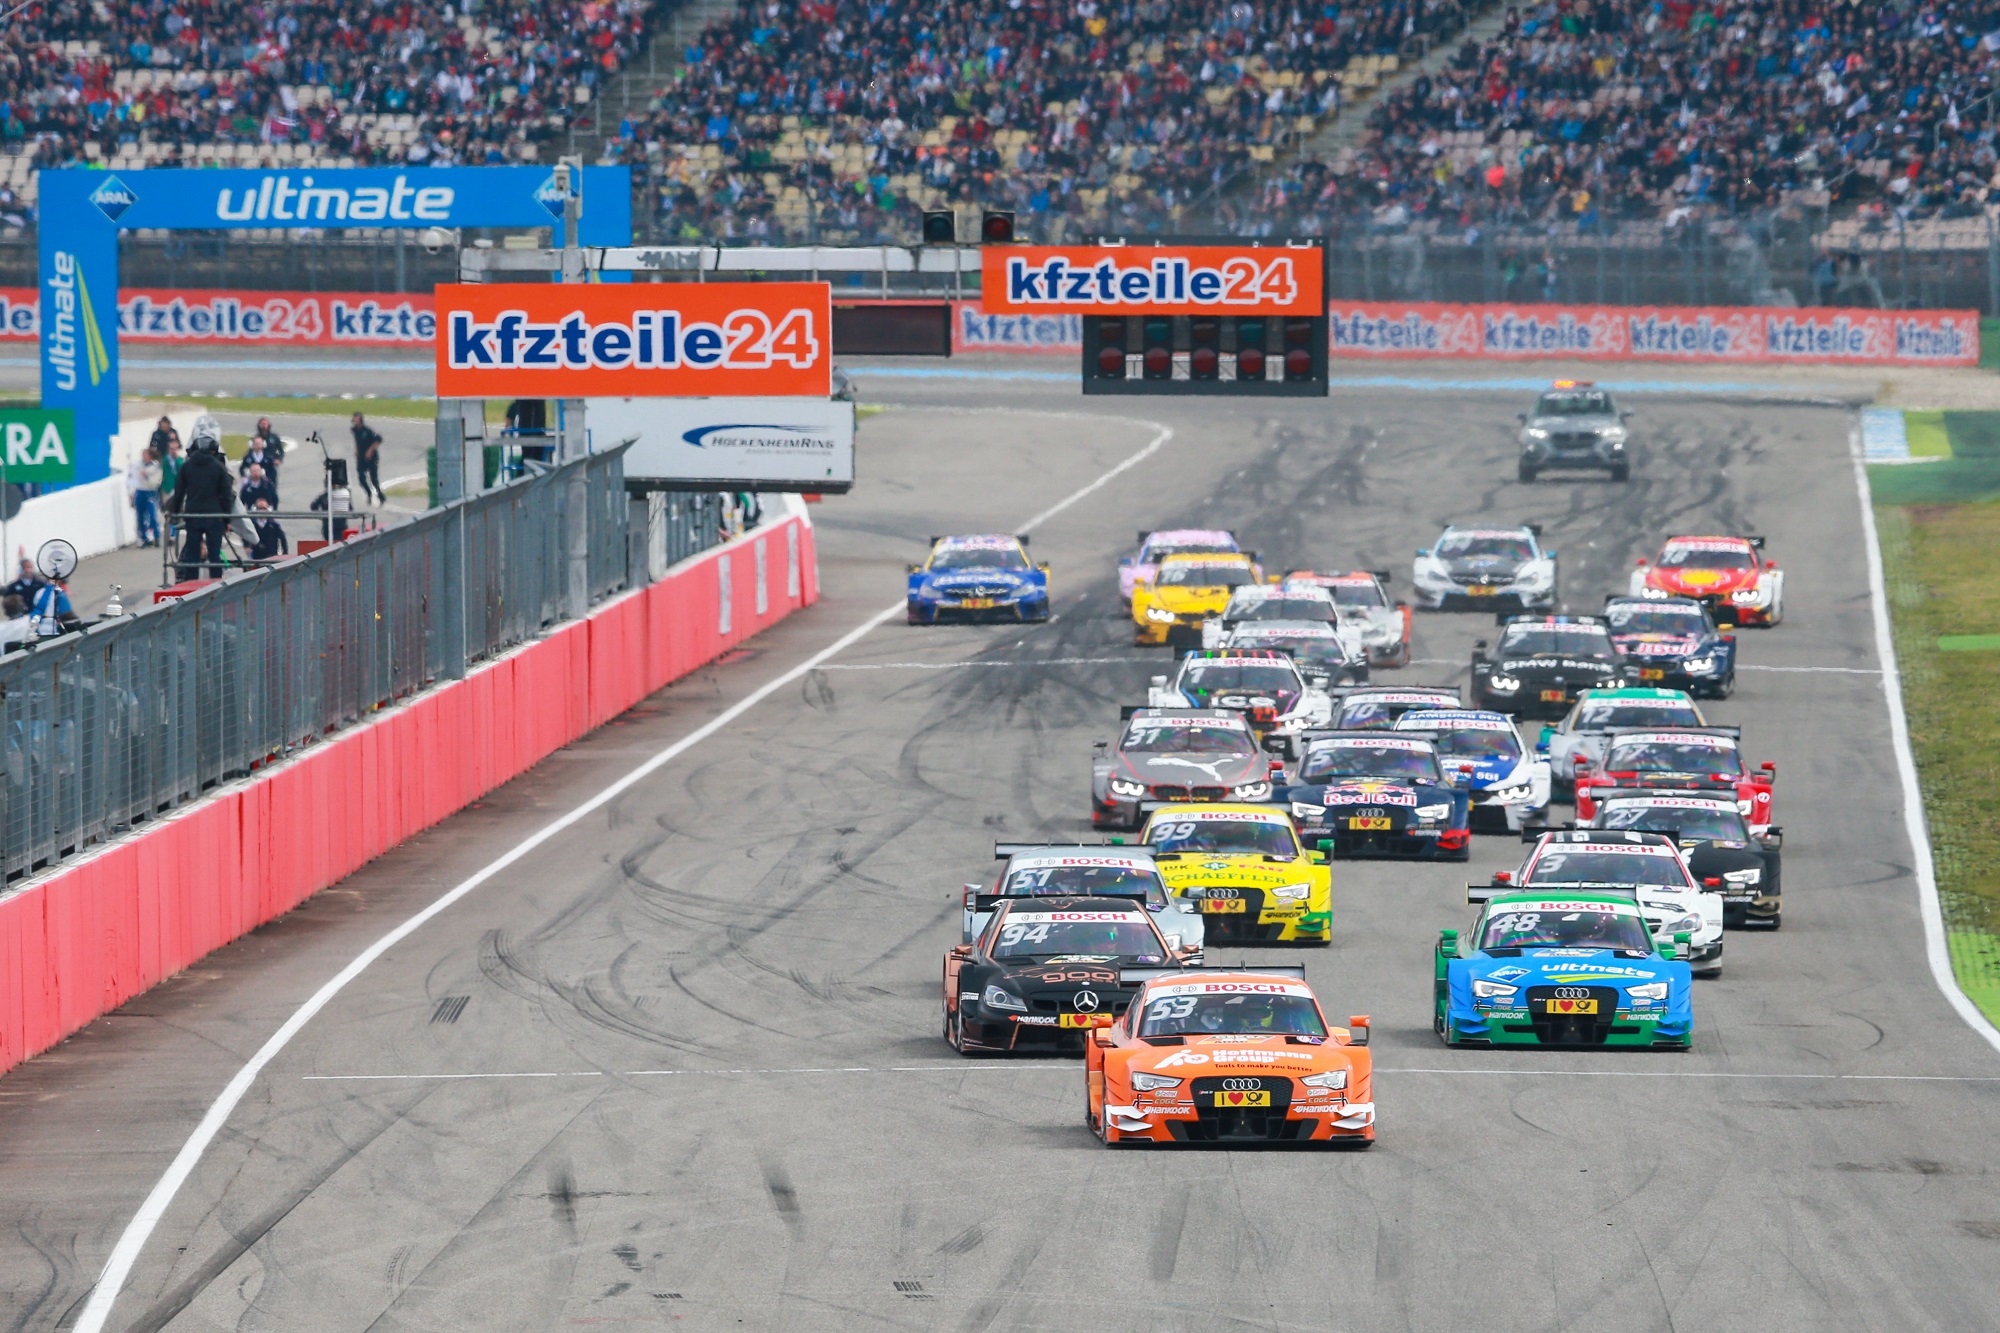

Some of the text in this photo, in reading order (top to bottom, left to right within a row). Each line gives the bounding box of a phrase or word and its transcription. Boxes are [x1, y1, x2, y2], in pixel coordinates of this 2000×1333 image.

[95, 191, 132, 204] ARAL
[216, 175, 456, 221] ultimate
[1007, 256, 1297, 305] kfzteile24
[48, 251, 76, 391] ultimate
[1329, 311, 1481, 353] kfzteile24
[1483, 312, 1627, 354] kfzteile24
[1629, 314, 1763, 356] kfzteile24
[448, 309, 818, 370] kfzteile24
[1224, 658, 1279, 667] BOSCH
[1385, 695, 1441, 703] BOSCH
[1620, 699, 1676, 707] BOSCH
[1582, 706, 1614, 723] 12
[1171, 718, 1230, 728] BOSCH
[1437, 720, 1498, 729] BOSCH
[1124, 728, 1161, 747] 31
[1352, 739, 1412, 748] BOSCH
[1655, 734, 1715, 745] BOSCH
[1324, 793, 1417, 807] Red Bull
[1652, 799, 1717, 808] BOSCH
[1201, 813, 1268, 822] BOSCH
[1606, 808, 1649, 826] 27
[1151, 823, 1196, 841] 99
[1584, 845, 1654, 853] BOSCH
[1062, 858, 1133, 867] BOSCH
[1537, 854, 1567, 874] 3
[1011, 868, 1054, 889] 51
[1163, 872, 1287, 884] SCHAEFFLER
[1540, 902, 1615, 912] BOSCH
[1051, 913, 1128, 921] BOSCH
[1488, 912, 1541, 932] 48
[1000, 923, 1052, 947] 94
[1493, 969, 1526, 978] ARAL
[1541, 963, 1657, 978] ultimate
[1205, 984, 1286, 993] BOSCH
[1148, 996, 1199, 1021] 53
[1212, 1049, 1313, 1060] Hoffmann
[1213, 1056, 1275, 1064] Group
